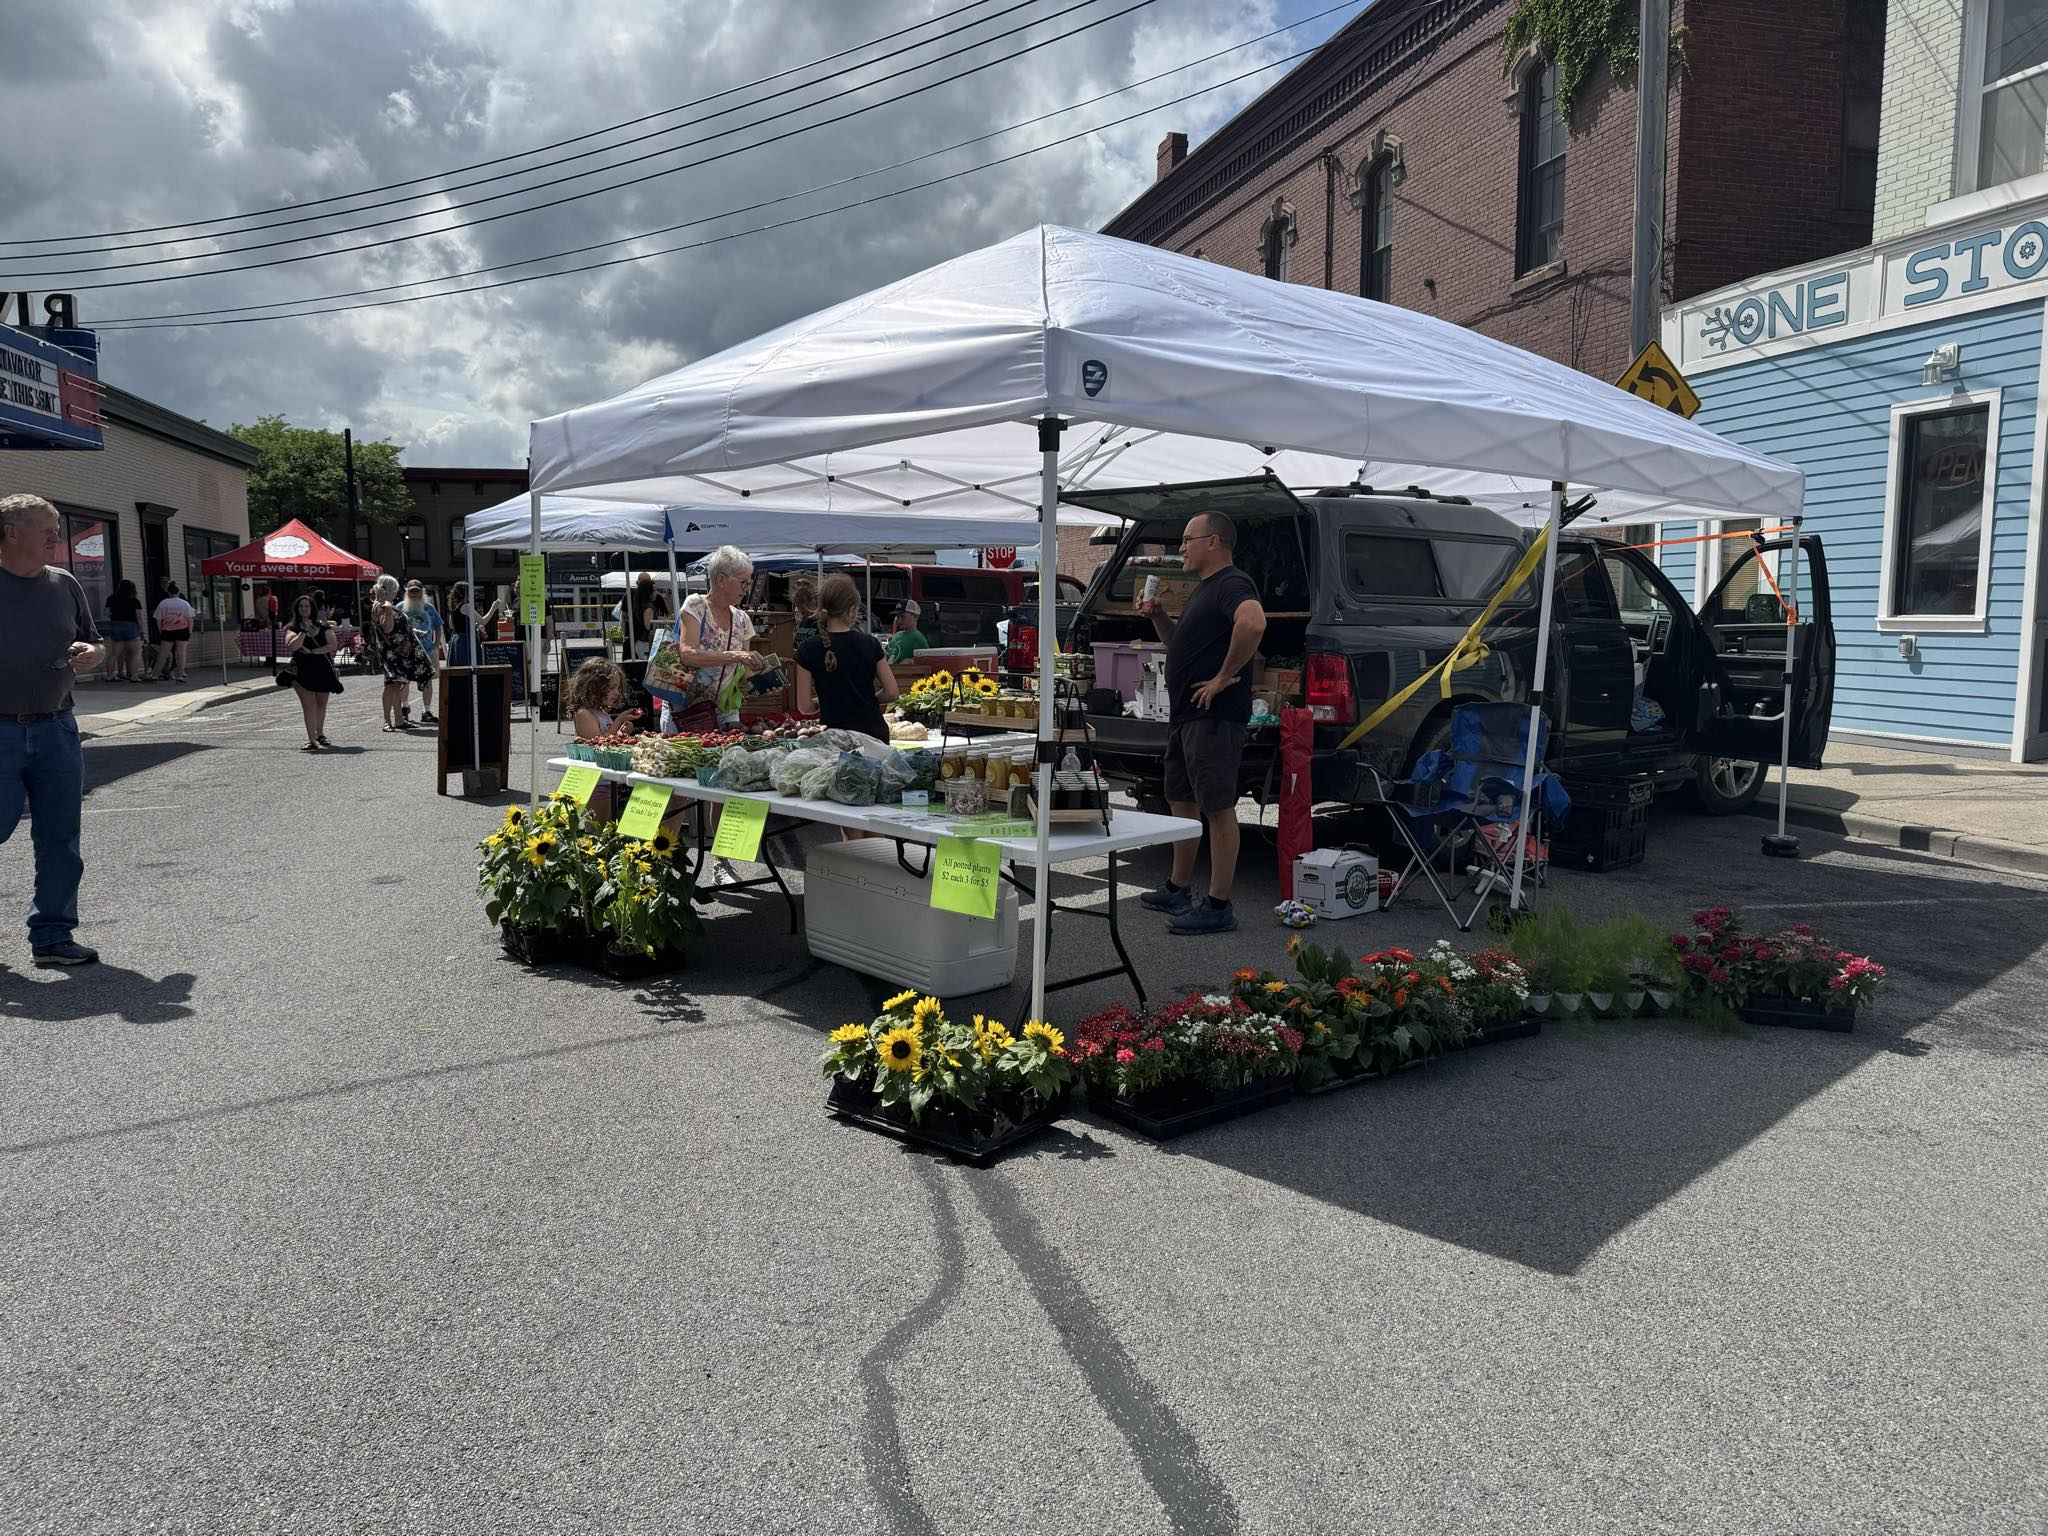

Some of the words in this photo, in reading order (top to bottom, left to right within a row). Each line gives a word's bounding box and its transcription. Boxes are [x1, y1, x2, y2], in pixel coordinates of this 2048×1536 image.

[1733, 271, 1848, 345] ONE
[1903, 220, 2048, 307] STO
[11, 381, 34, 407] THIS
[987, 546, 1015, 559] STOP
[225, 561, 256, 573] Your
[260, 563, 299, 573] sweet
[303, 565, 335, 576] spot.
[569, 574, 588, 582] Aunt
[943, 858, 952, 867] All
[953, 861, 972, 871] potted
[972, 862, 992, 874] plants
[941, 871, 950, 881] $2
[950, 874, 964, 883] each
[970, 876, 979, 886] for
[980, 878, 990, 888] $5
